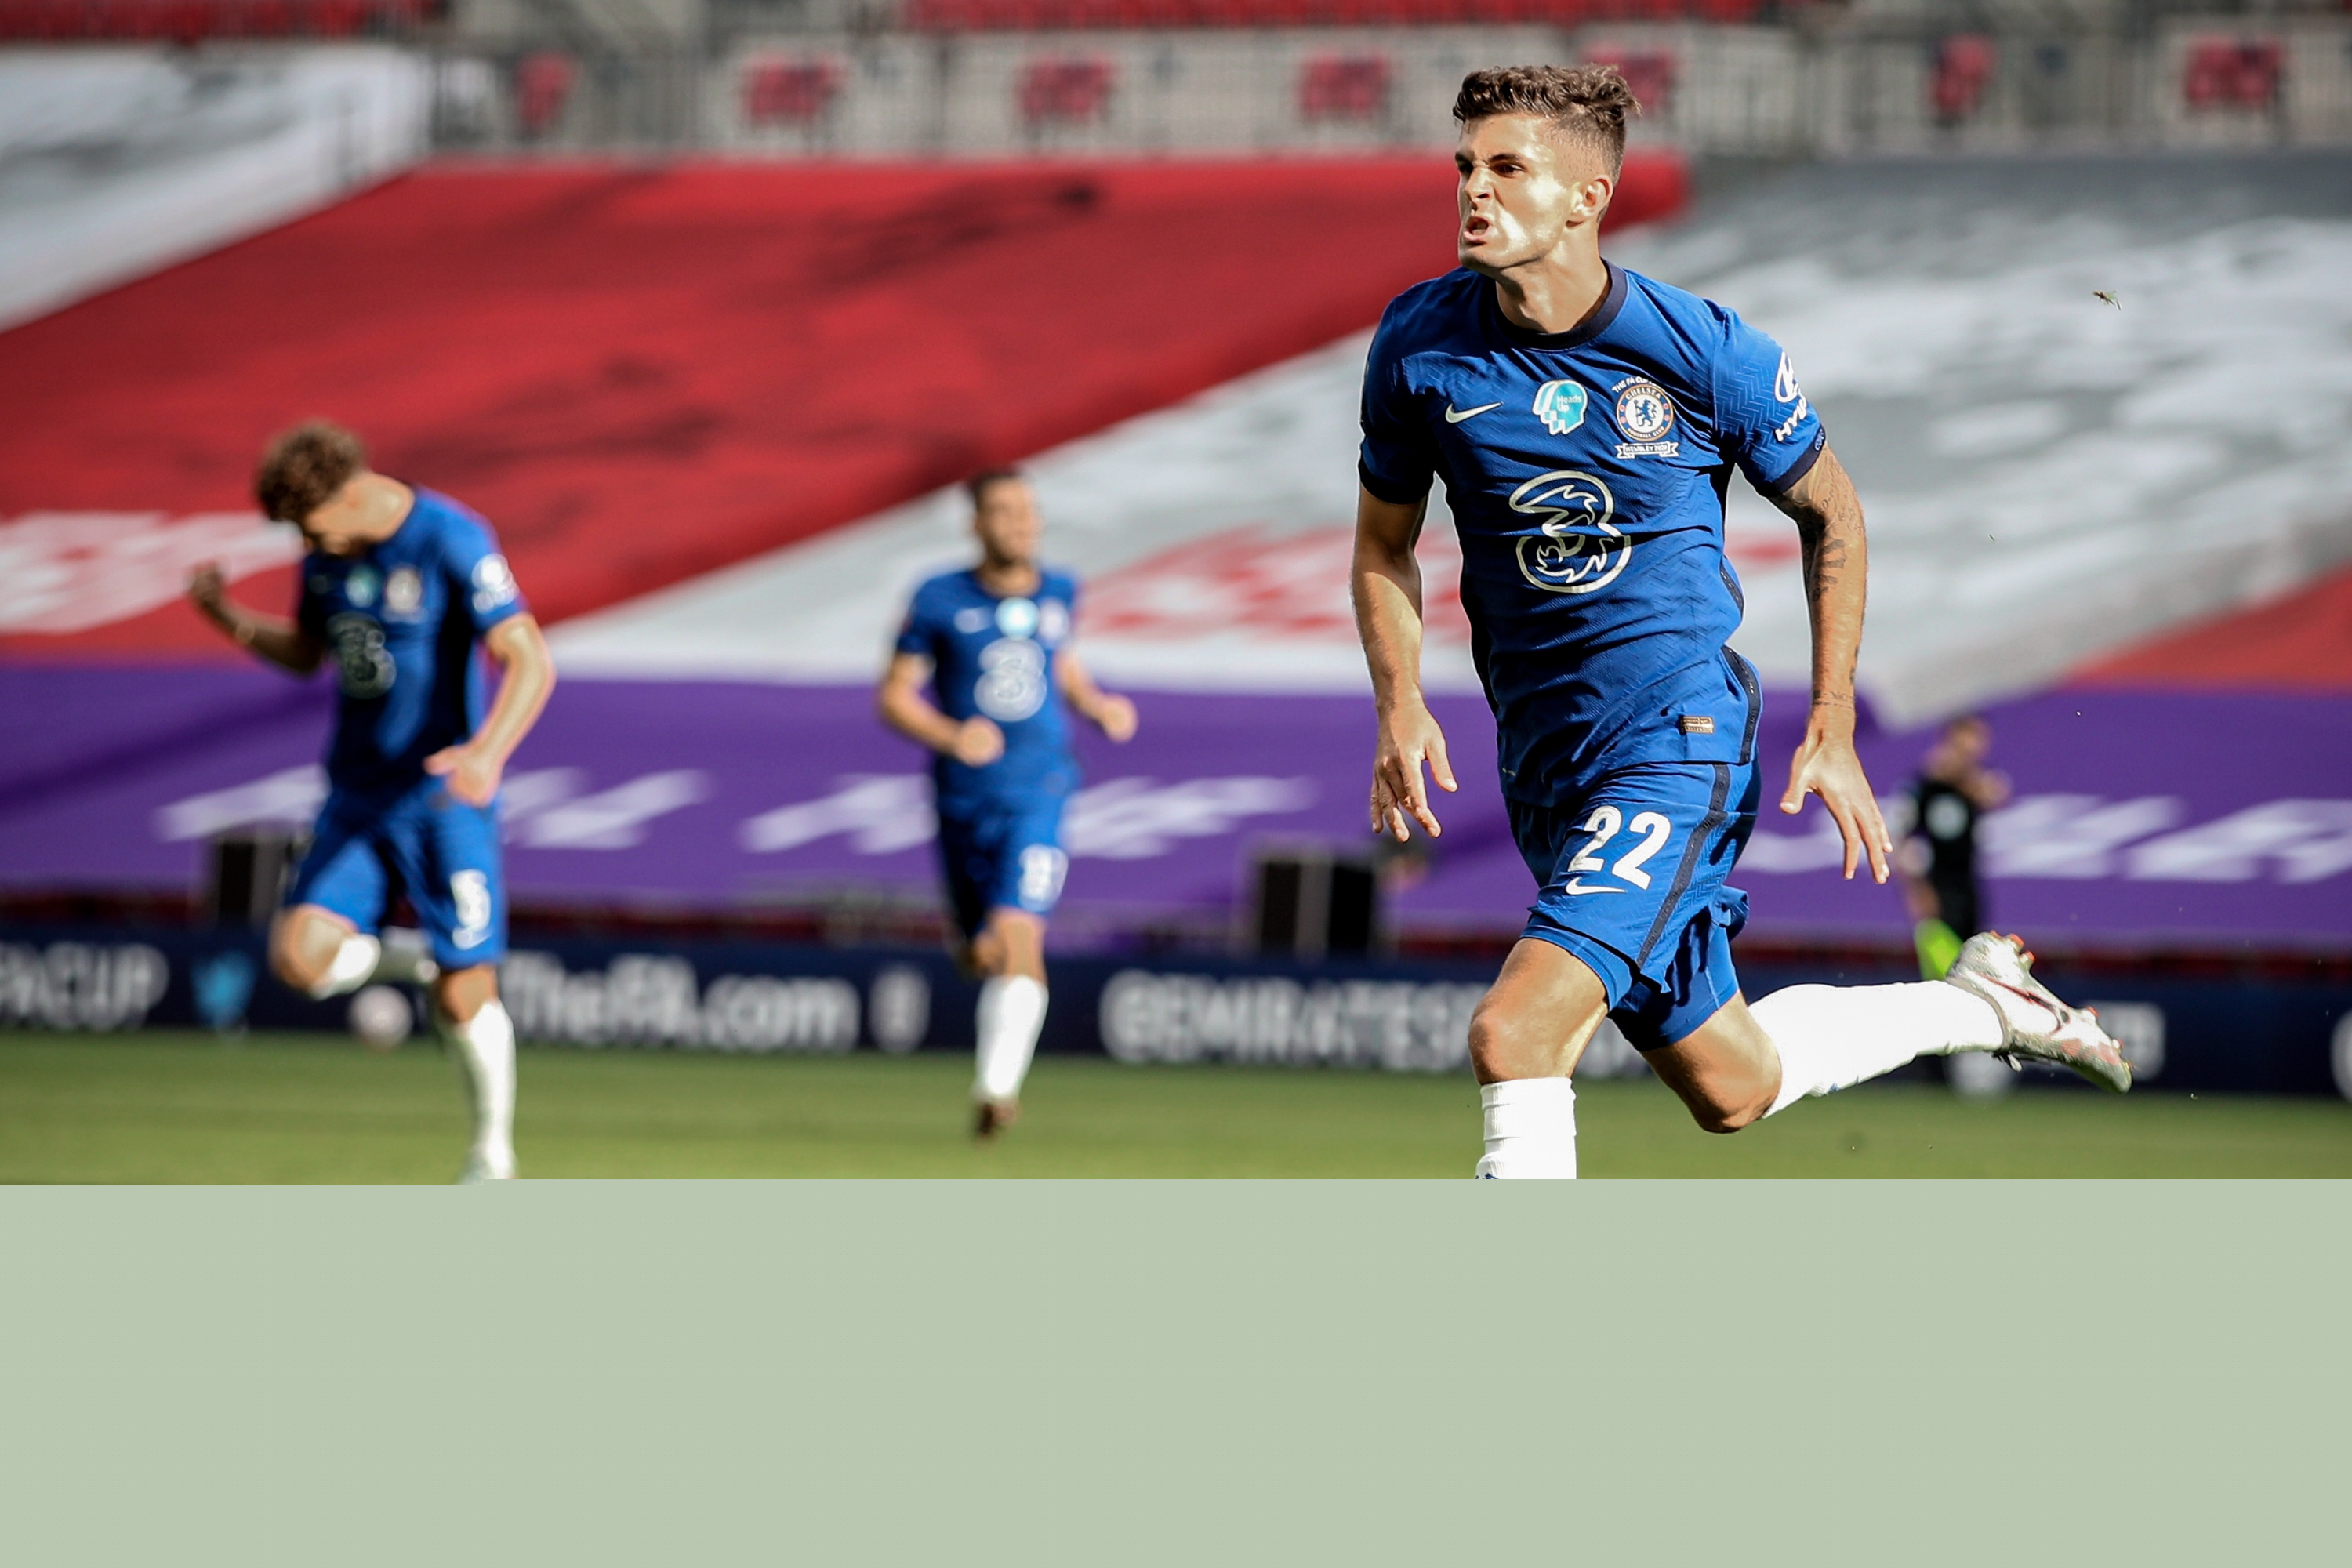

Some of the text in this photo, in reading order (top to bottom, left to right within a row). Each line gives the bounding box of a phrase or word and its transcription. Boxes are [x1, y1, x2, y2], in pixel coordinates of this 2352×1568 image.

[1556, 394, 1582, 404] Heads
[1625, 387, 1661, 400] CHELSEA
[1568, 805, 1671, 891] 22
